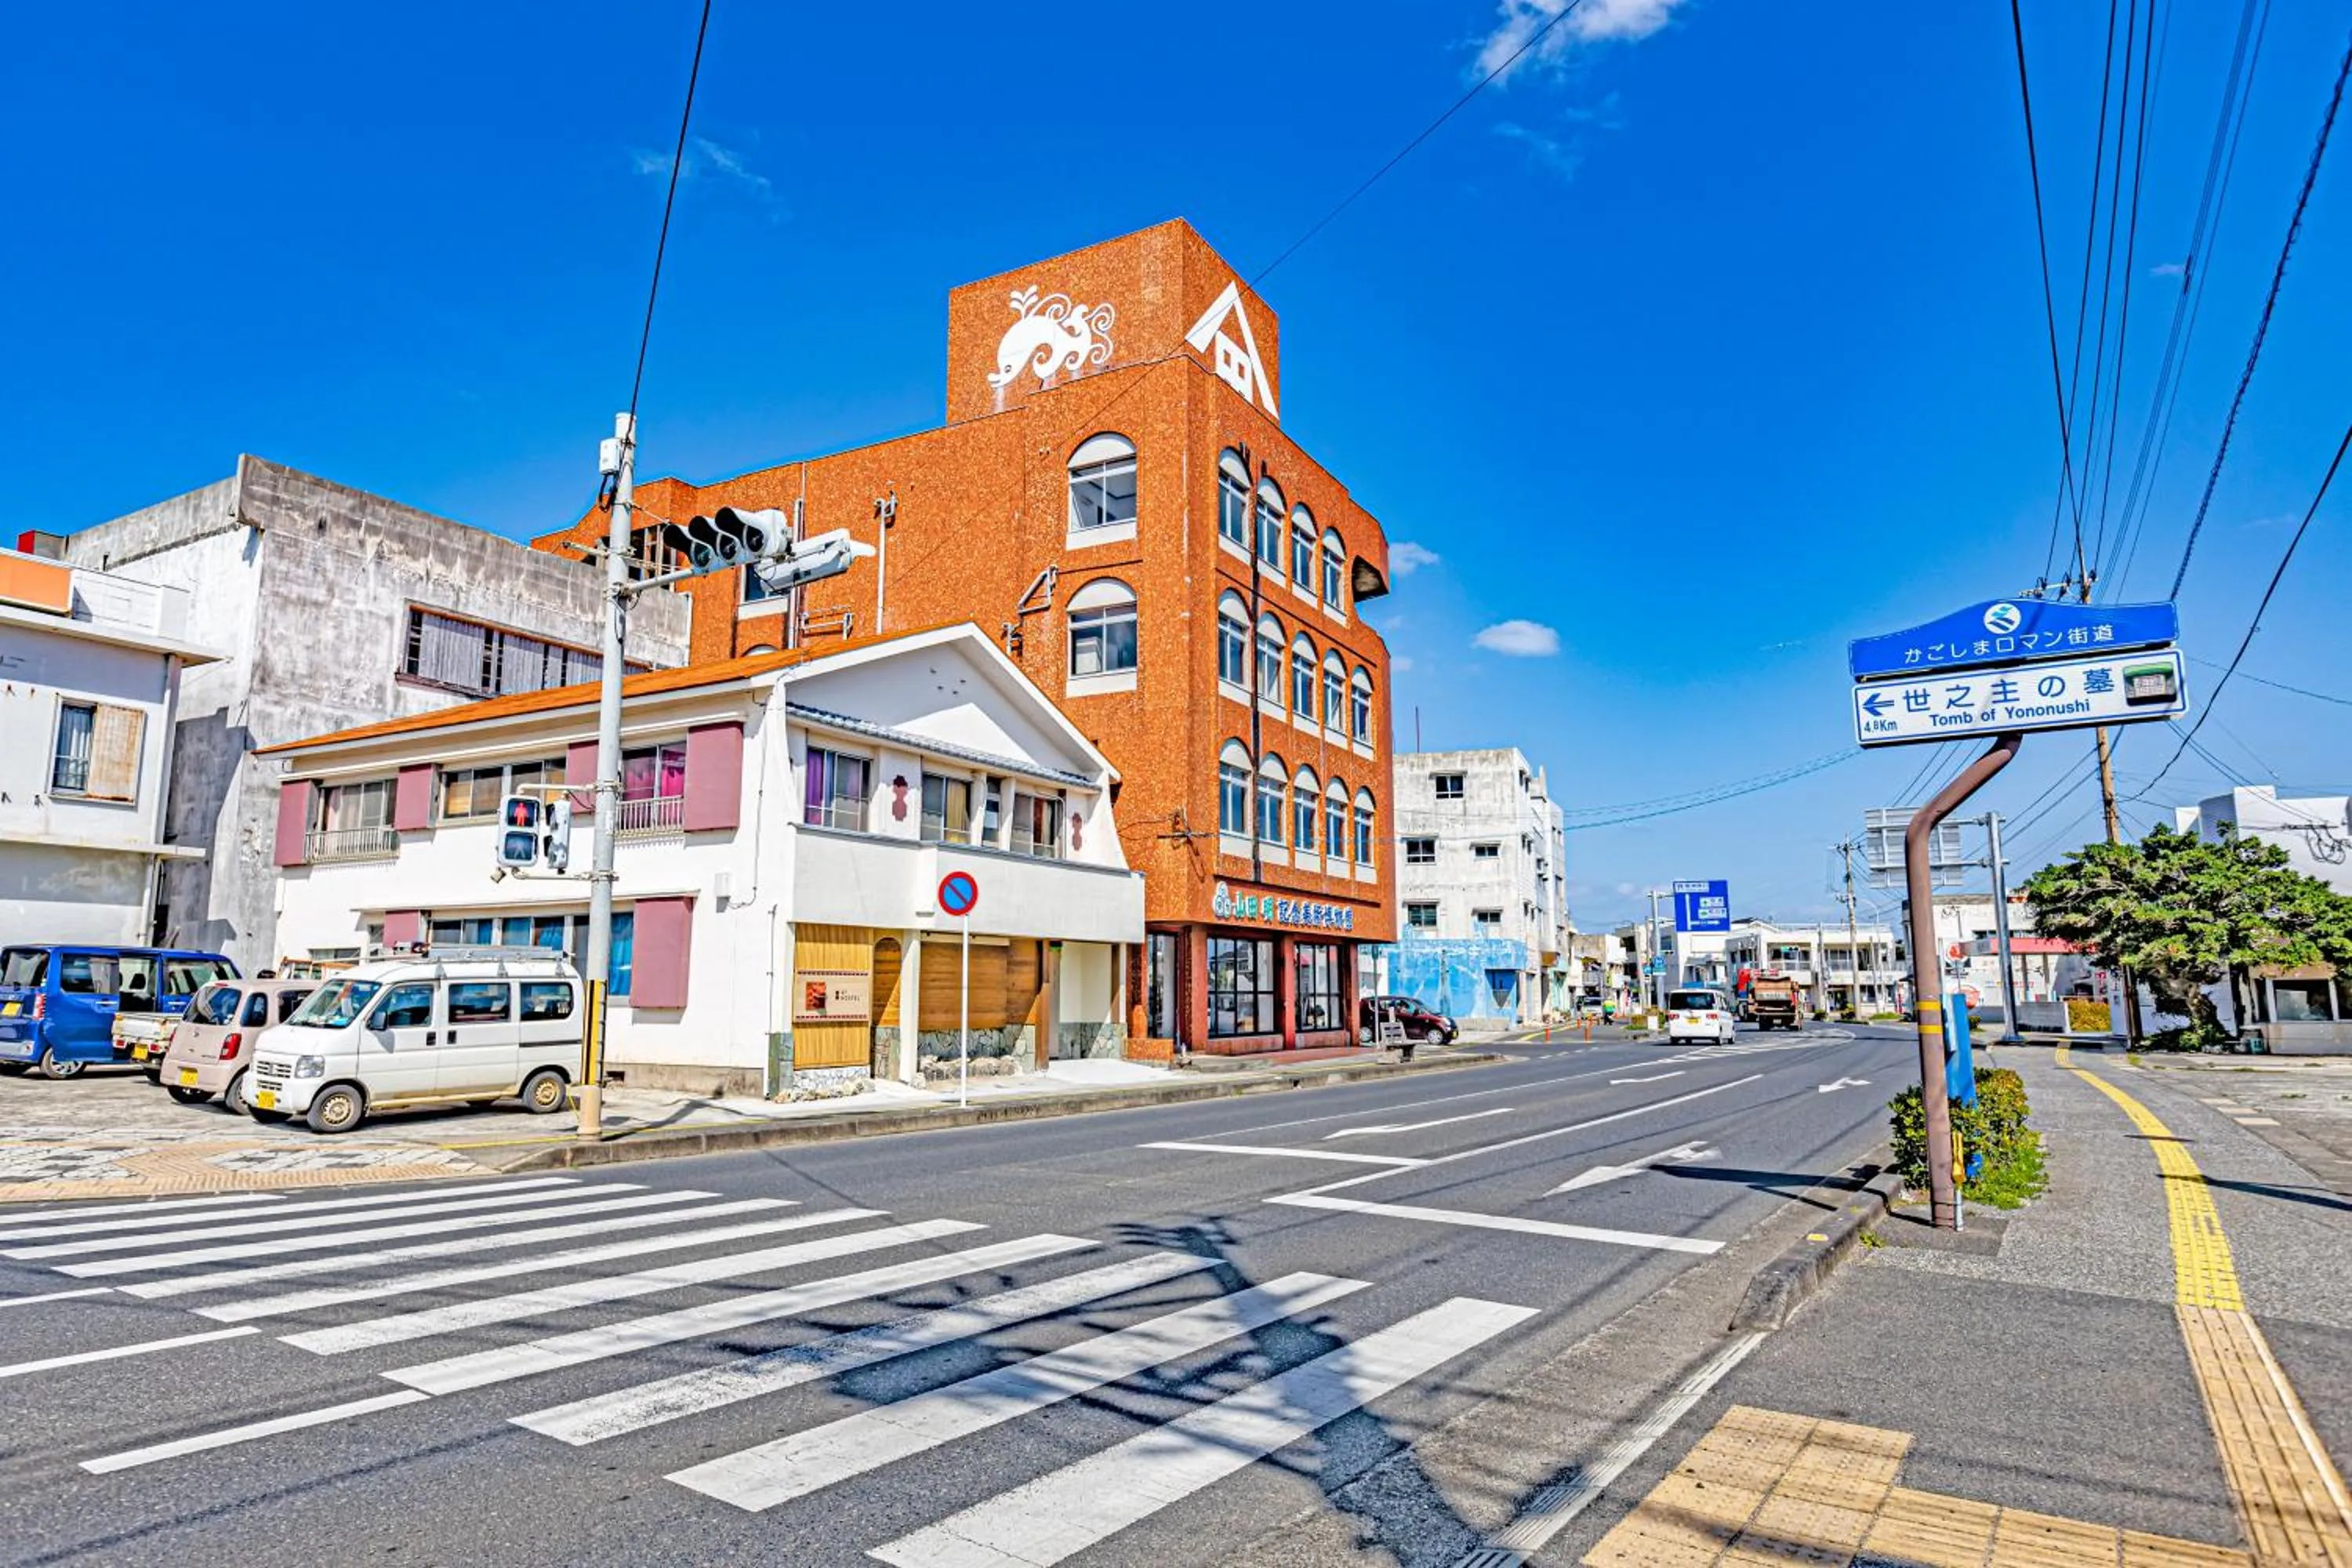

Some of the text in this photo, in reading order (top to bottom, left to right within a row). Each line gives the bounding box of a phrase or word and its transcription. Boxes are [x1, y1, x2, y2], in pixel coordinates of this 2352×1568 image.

[1905, 624, 2114, 662] かごしまロマン街道
[1903, 668, 2114, 713] 世之主の墓
[1929, 699, 2090, 727] Tomb of Yononushi
